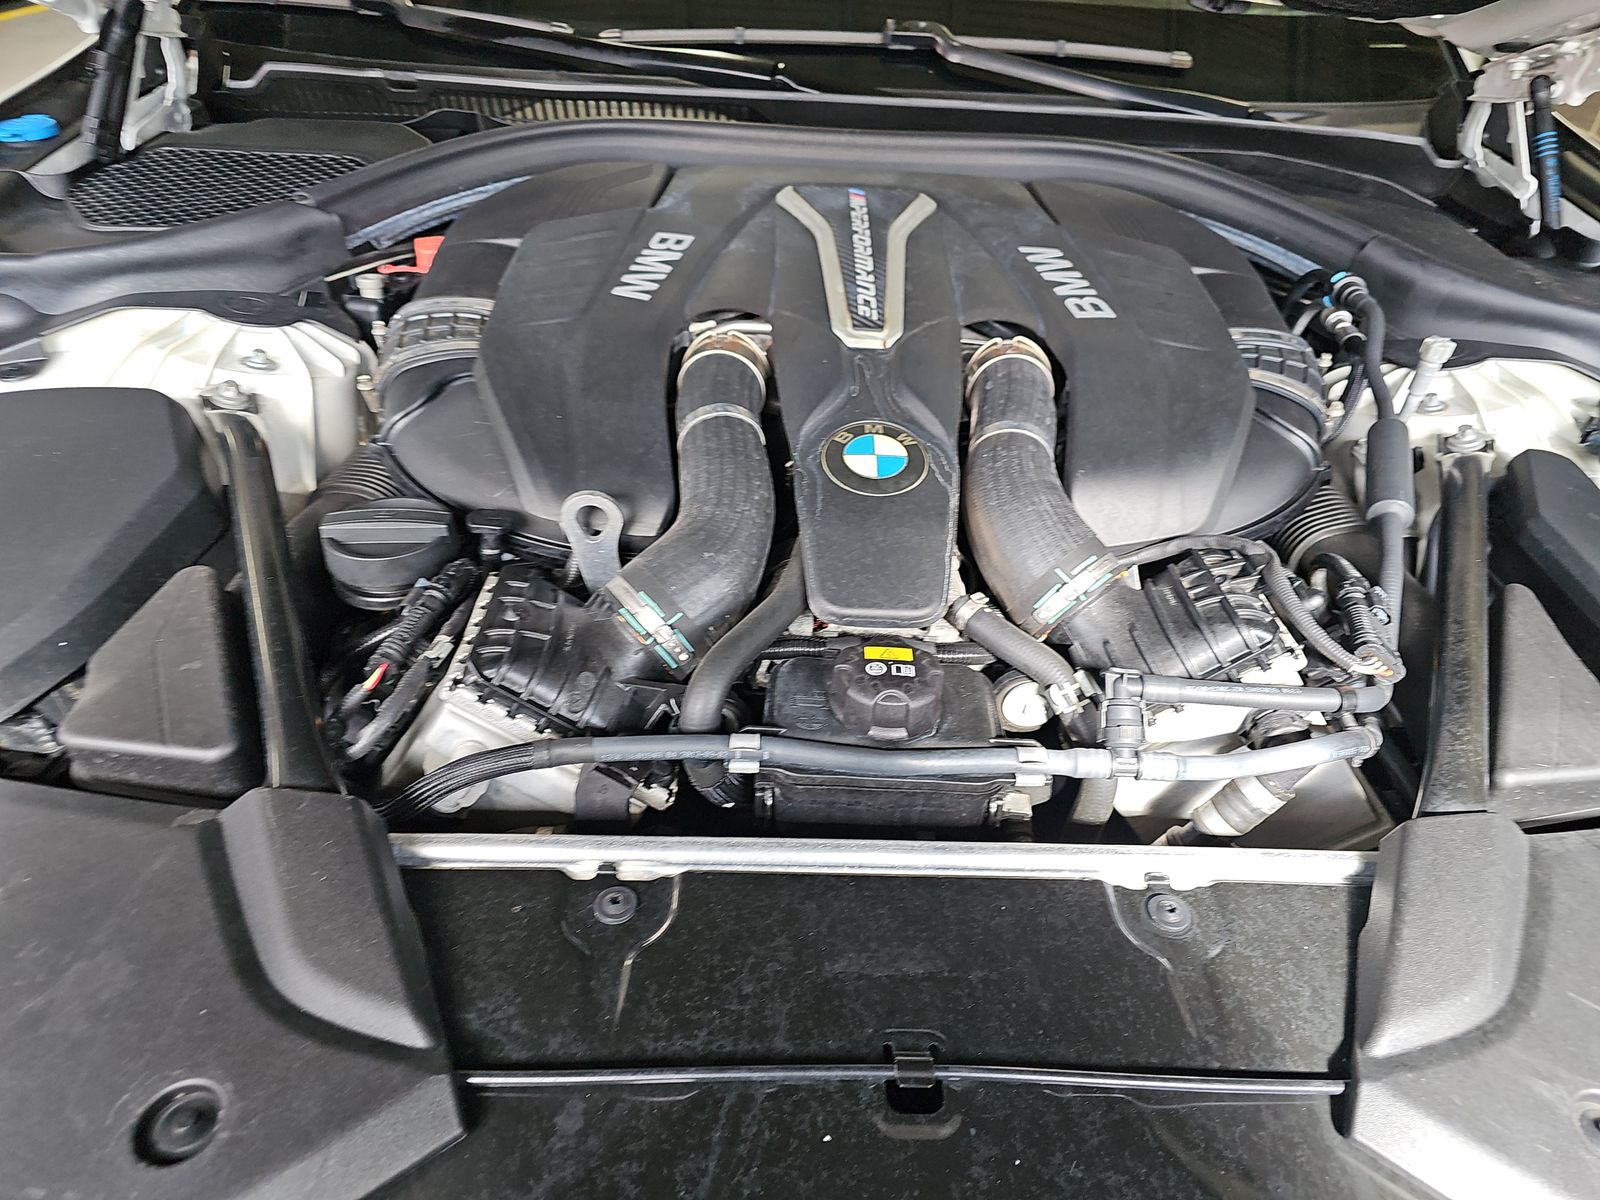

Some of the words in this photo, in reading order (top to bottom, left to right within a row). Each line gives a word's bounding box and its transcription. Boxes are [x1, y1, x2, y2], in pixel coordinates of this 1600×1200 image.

[610, 231, 696, 302] BMW
[849, 205, 879, 322] PERFORMANCE
[1017, 245, 1117, 319] BMW
[831, 423, 919, 446] BMW
